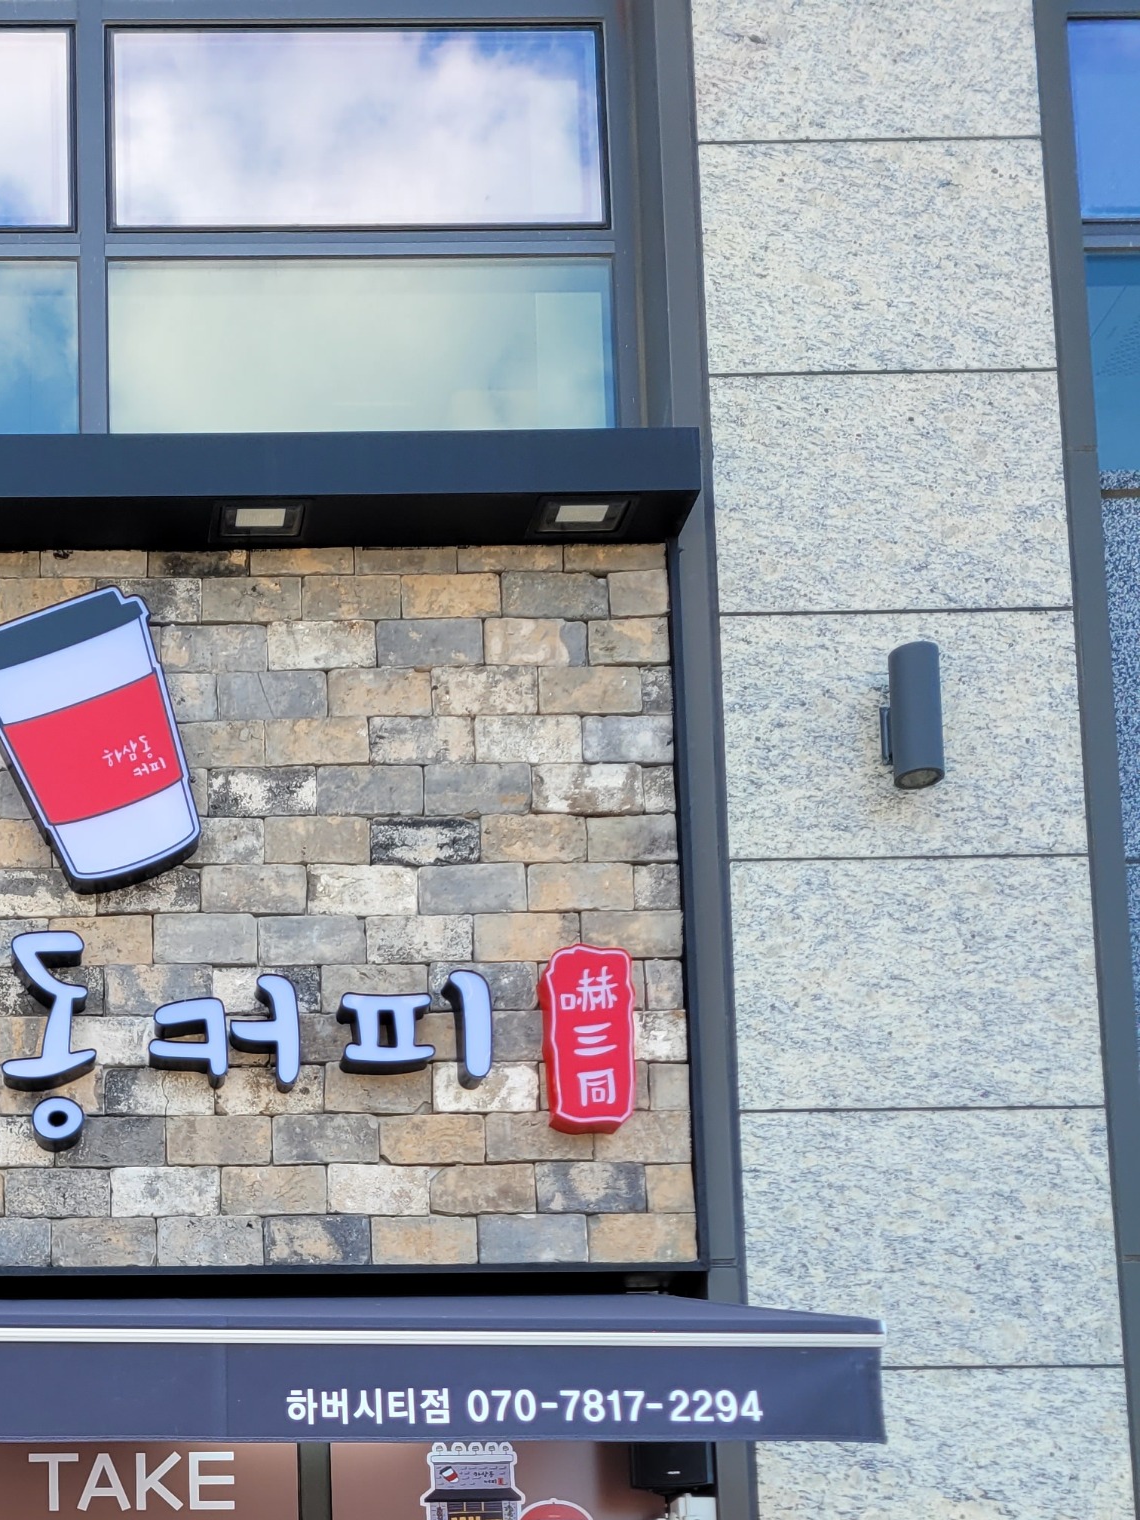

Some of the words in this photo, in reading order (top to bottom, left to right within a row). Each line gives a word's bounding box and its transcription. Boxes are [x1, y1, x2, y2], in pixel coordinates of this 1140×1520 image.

[102, 735, 153, 767] 하삼동
[133, 757, 166, 776] 커피
[286, 1388, 451, 1425] 하버시티점
[467, 1389, 764, 1423] 070-7817-2294
[28, 1451, 236, 1512] TAKE
